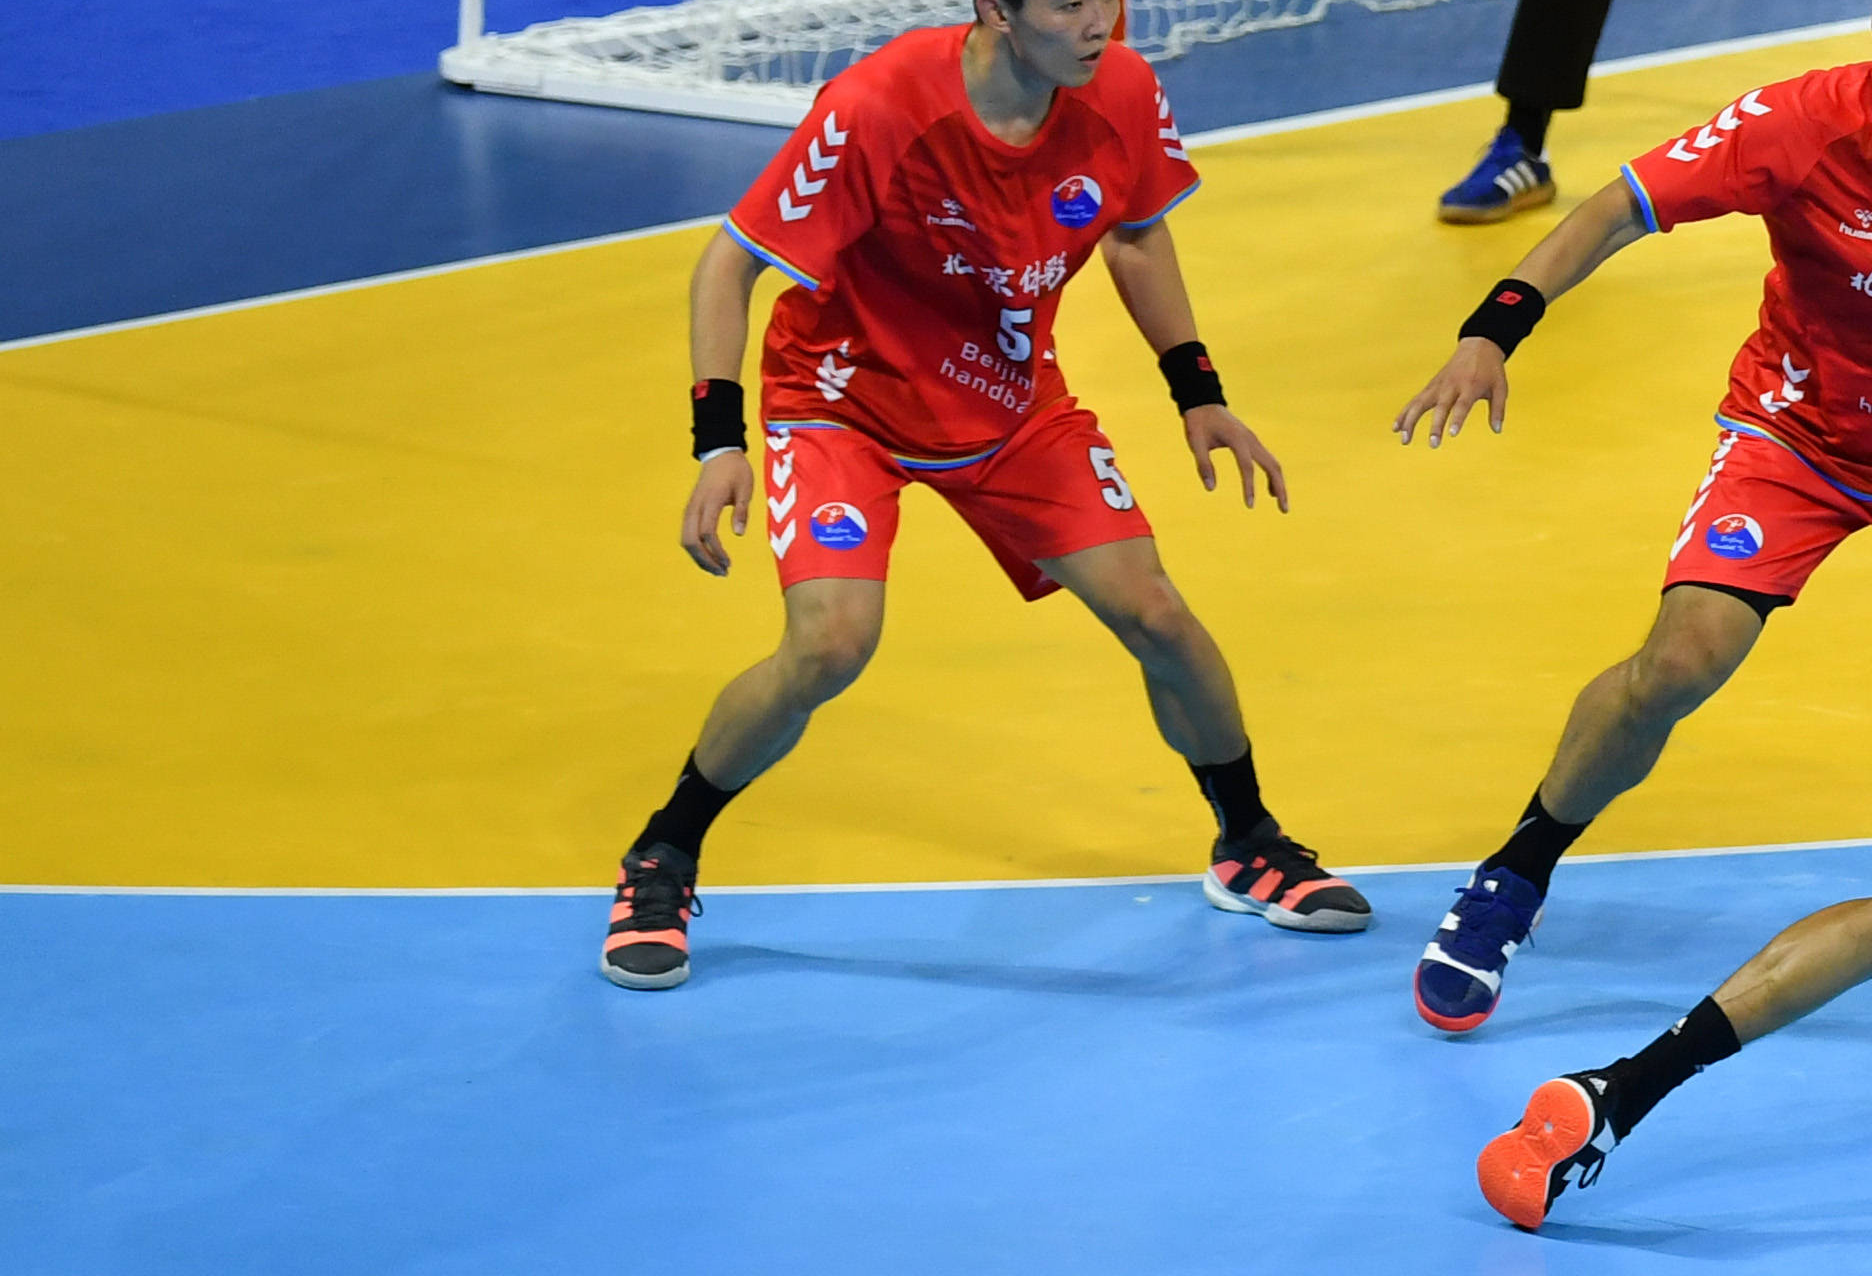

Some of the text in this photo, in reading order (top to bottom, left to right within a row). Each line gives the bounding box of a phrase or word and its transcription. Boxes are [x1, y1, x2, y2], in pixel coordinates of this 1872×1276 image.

[942, 251, 1068, 297] 北京体彩
[996, 307, 1034, 363] 5
[939, 357, 1030, 414] handba
[960, 341, 1034, 392] Beijin
[1087, 444, 1134, 512] 5
